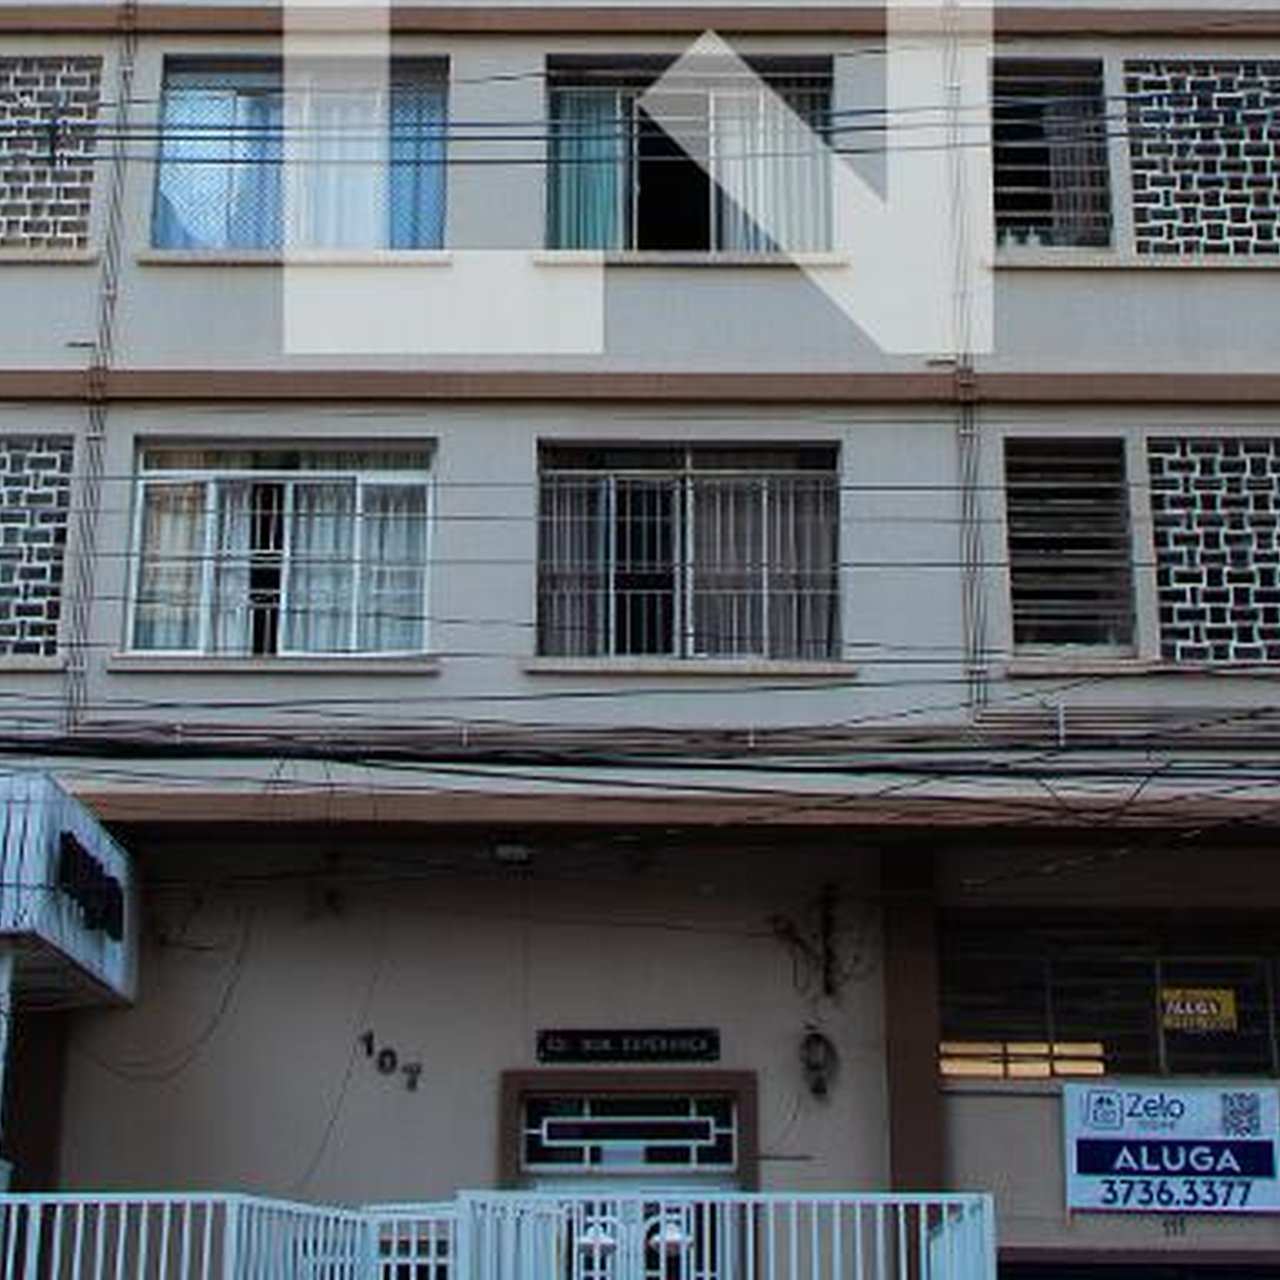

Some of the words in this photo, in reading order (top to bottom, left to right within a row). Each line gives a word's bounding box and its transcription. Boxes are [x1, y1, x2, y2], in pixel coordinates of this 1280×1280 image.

[359, 1028, 422, 1094] 107
[1126, 1093, 1186, 1118] Zelo
[1113, 1146, 1242, 1173] ALUGA
[1100, 1179, 1254, 1207] 3736.3377
